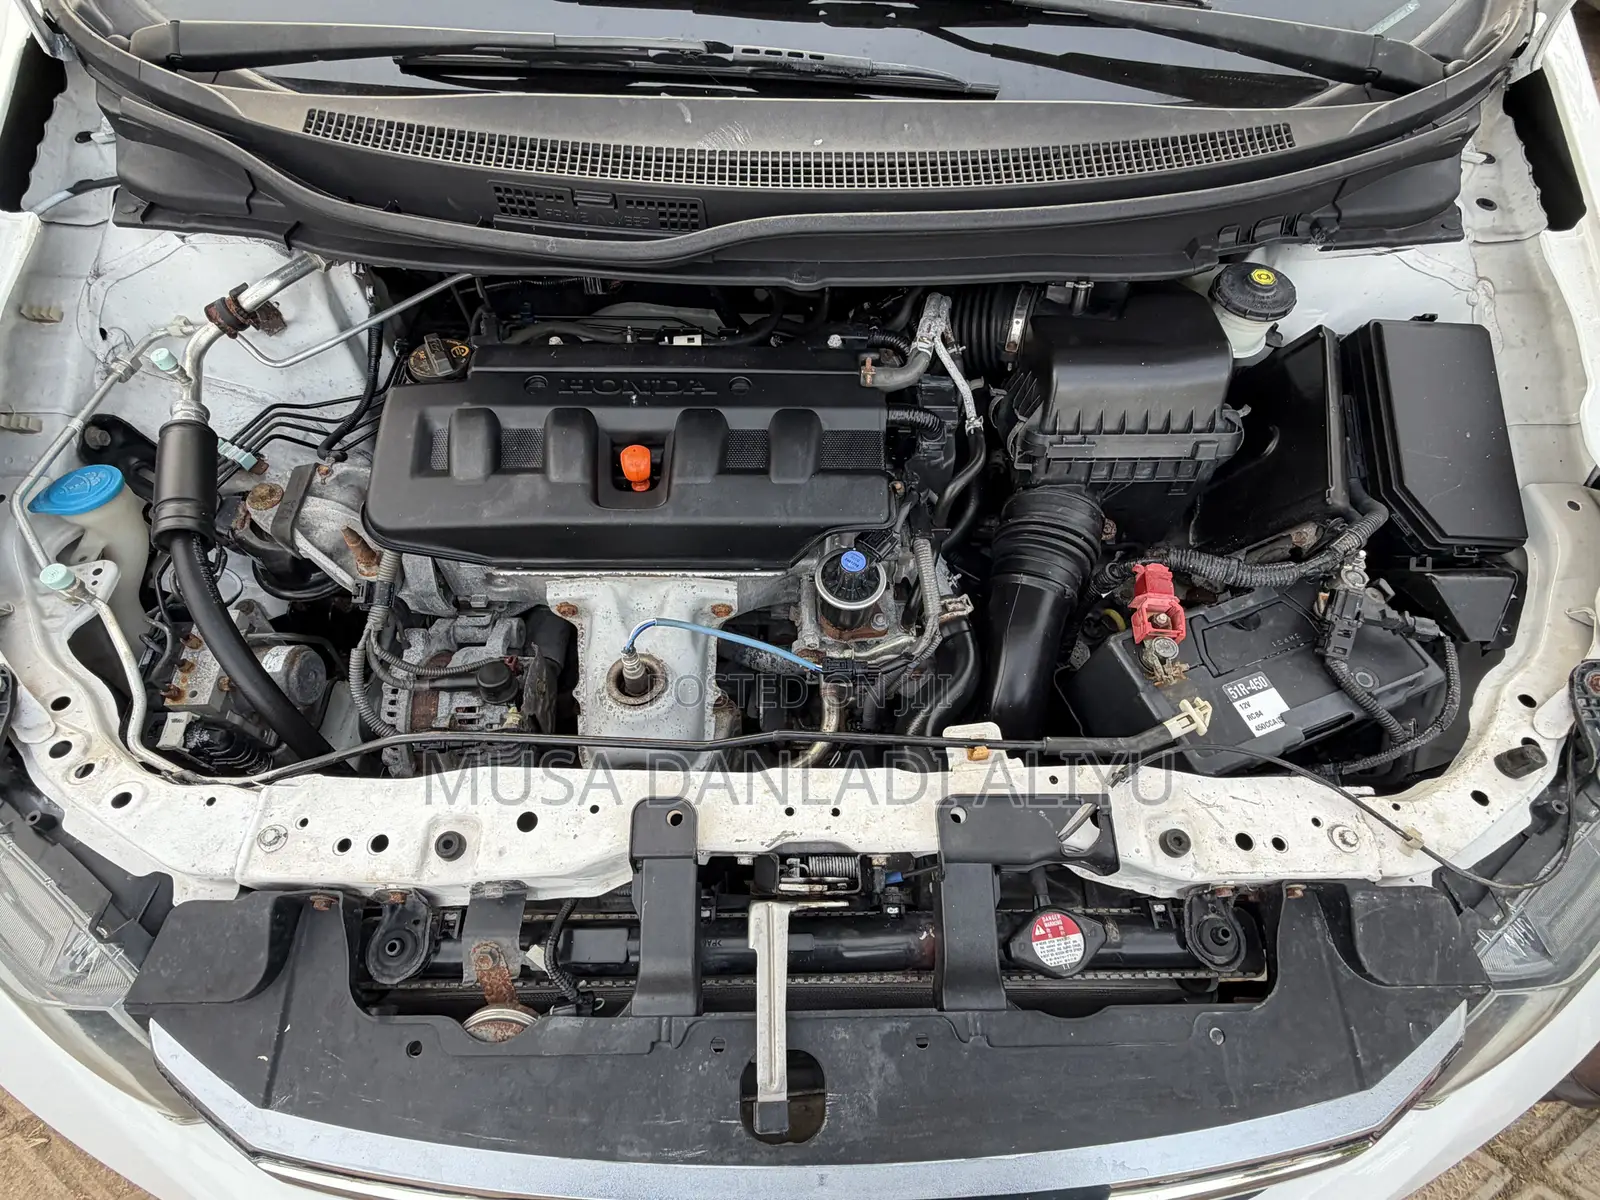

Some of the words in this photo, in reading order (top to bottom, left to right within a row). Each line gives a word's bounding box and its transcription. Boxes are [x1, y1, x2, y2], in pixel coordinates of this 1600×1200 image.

[558, 379, 718, 396] HONDA
[1227, 676, 1269, 699] 51R-450
[1239, 700, 1251, 711] 12V
